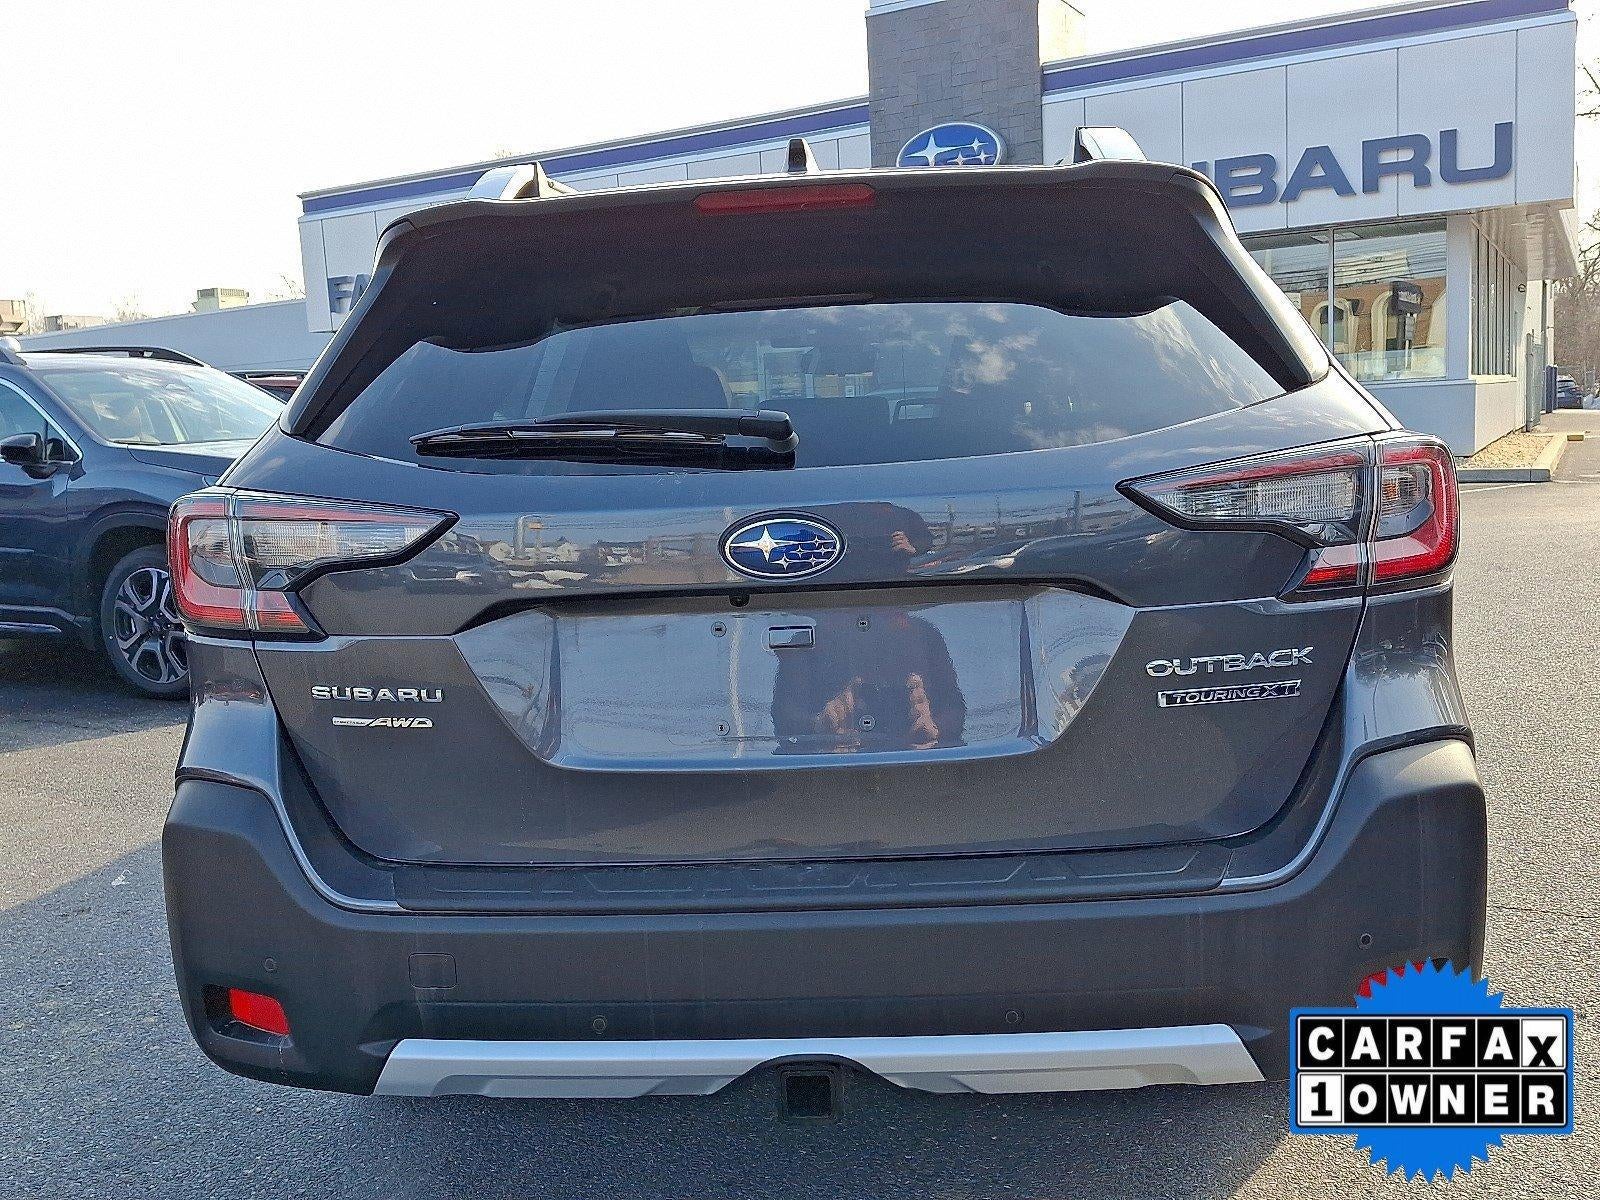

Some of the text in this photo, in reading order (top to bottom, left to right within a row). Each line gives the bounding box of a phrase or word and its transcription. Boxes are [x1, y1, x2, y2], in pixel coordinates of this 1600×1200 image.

[1192, 121, 1514, 207] BARU
[1145, 646, 1314, 677] OUTBACK
[311, 685, 444, 703] SUBARU
[368, 717, 433, 728] AWD
